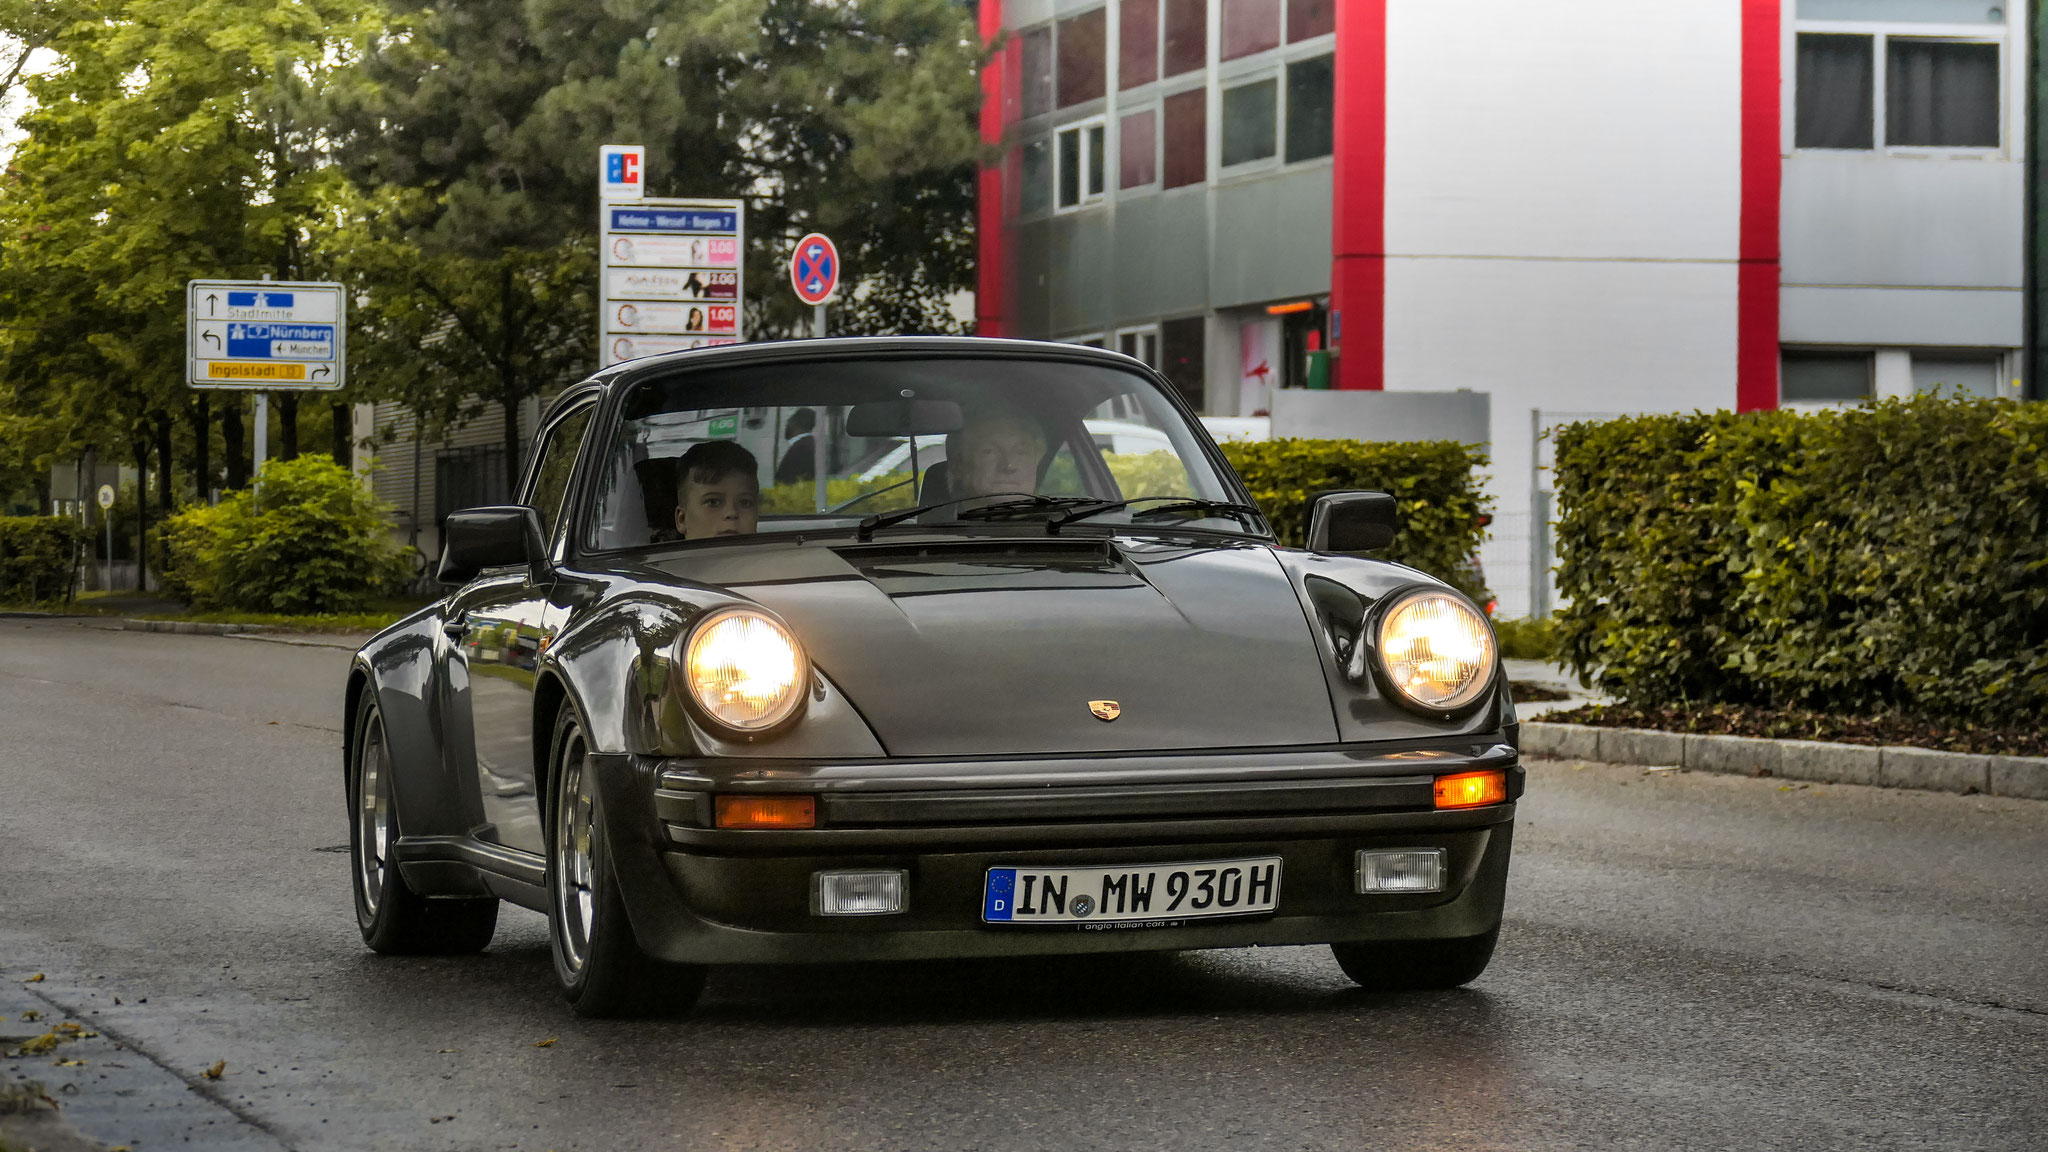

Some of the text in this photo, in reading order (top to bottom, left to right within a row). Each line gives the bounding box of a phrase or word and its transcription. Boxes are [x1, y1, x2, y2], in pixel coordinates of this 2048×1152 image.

[227, 308, 293, 319] Stadtmitte
[270, 326, 331, 342] Nürnberg
[290, 345, 329, 355] München
[211, 364, 275, 377] Ingolstadt
[994, 864, 1274, 915] D IN MW 930H
[1085, 922, 1112, 931] anglo
